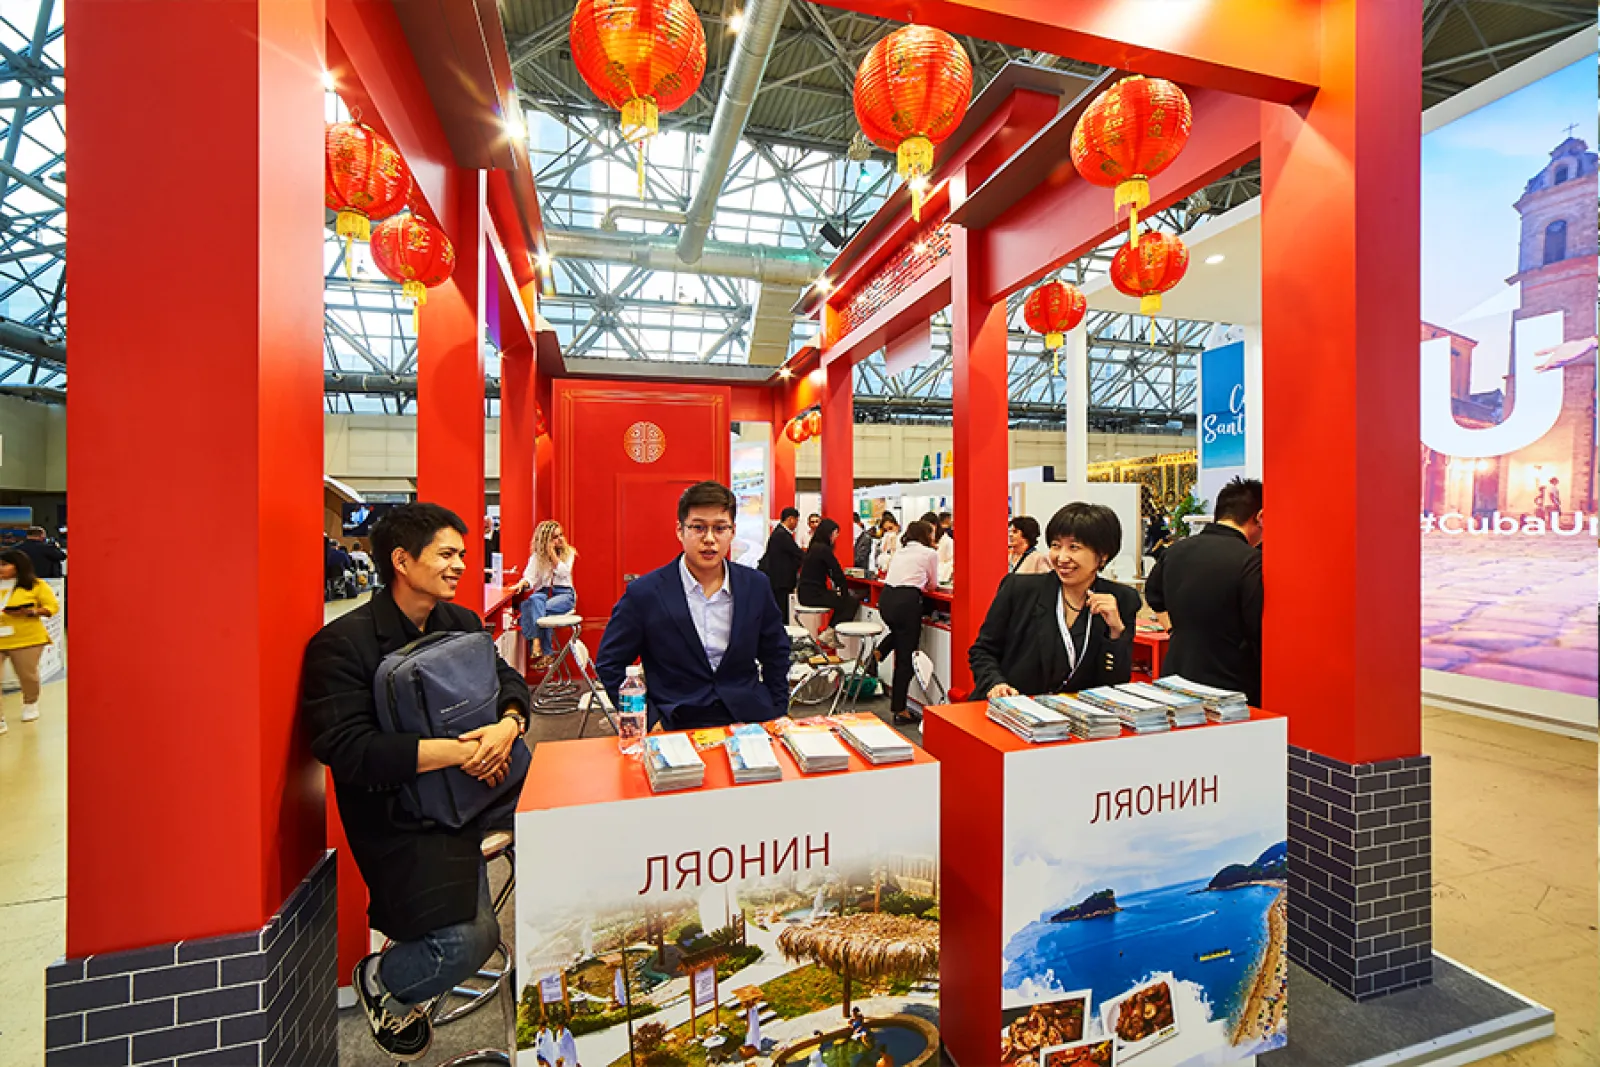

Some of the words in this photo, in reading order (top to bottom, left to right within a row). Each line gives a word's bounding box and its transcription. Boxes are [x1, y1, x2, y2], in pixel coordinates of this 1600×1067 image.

[1229, 383, 1246, 414] C
[1203, 413, 1247, 443] Sant
[1089, 774, 1218, 824] ЛЯОНИН
[637, 831, 830, 895] ЛЯОНИН
